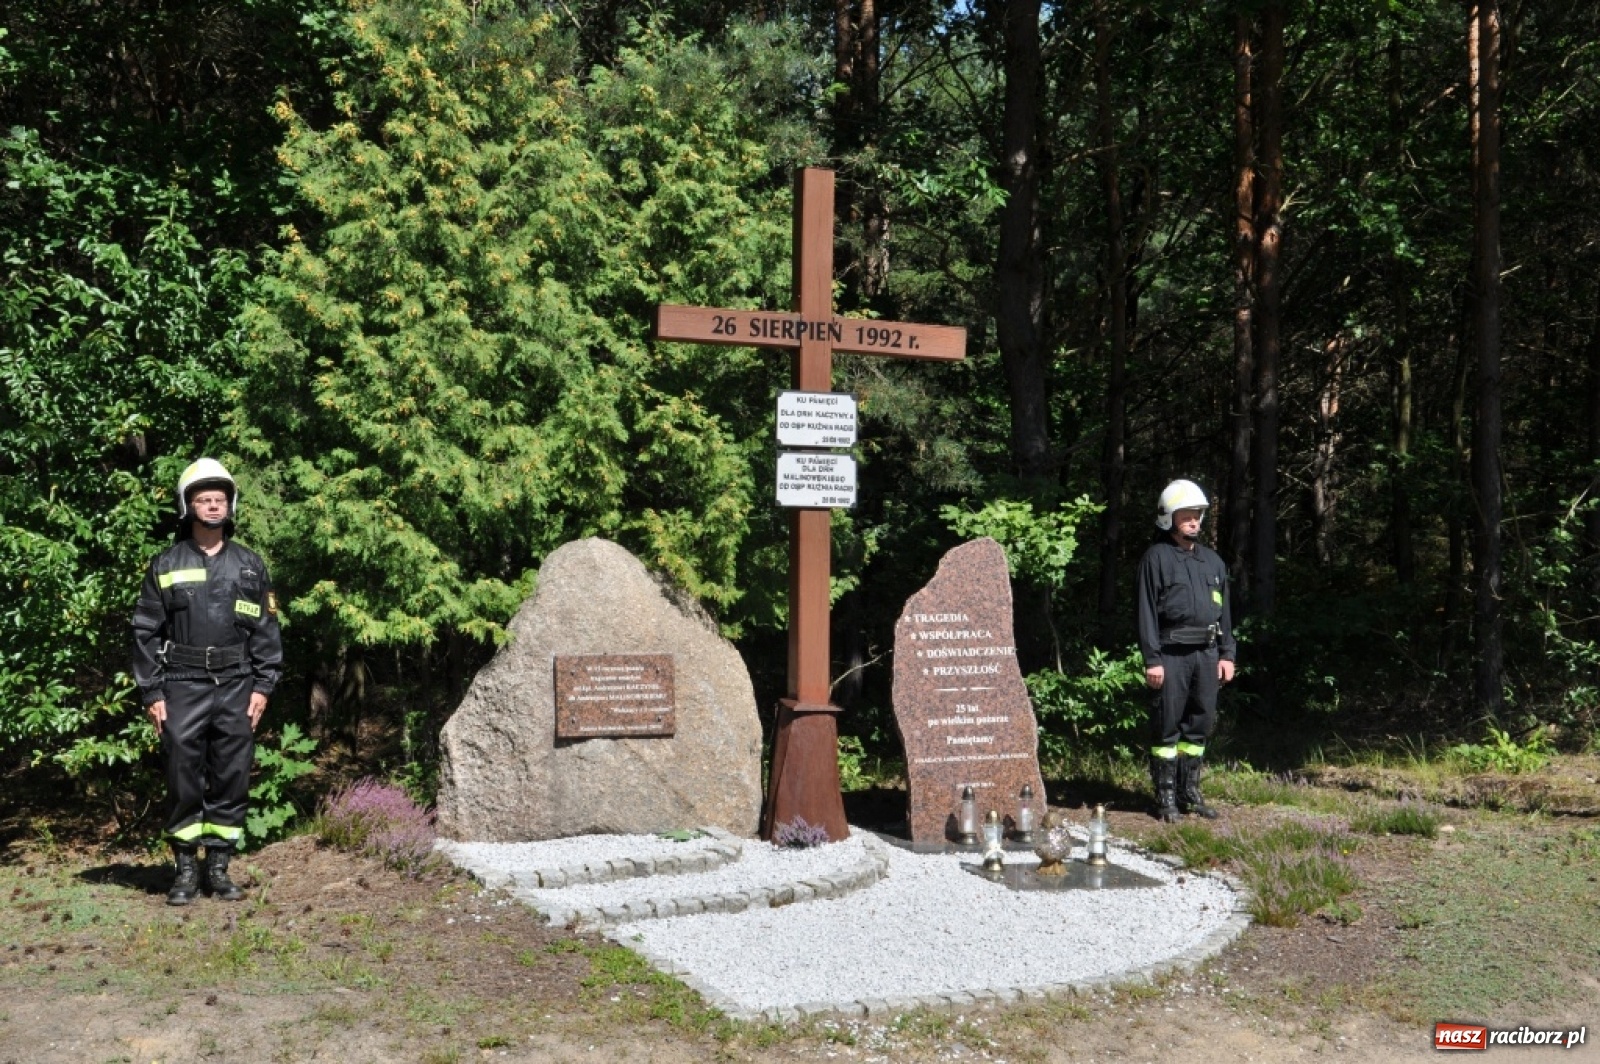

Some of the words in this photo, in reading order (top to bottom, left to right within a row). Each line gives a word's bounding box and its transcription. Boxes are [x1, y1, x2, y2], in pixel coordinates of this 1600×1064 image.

[711, 315, 737, 336] 26
[749, 316, 843, 343] SIERPIEŃ
[855, 326, 903, 347] 1992
[908, 335, 920, 350] r.
[796, 396, 807, 404] KU
[780, 409, 796, 417] DLA
[779, 421, 790, 429] OD
[795, 457, 807, 465] KU
[801, 465, 817, 473] DLA
[818, 465, 834, 473] DRH
[779, 482, 790, 490] OD
[913, 613, 969, 623] TRAGEDIA
[918, 629, 993, 640] WSPÓŁPRACA
[926, 646, 1016, 659] DOŚWIADCZENIE
[933, 663, 1002, 676] PRZYSZŁOŚĆ
[955, 704, 966, 713] 25
[941, 715, 975, 725] wielkim
[946, 735, 995, 746] Pamiętamy
